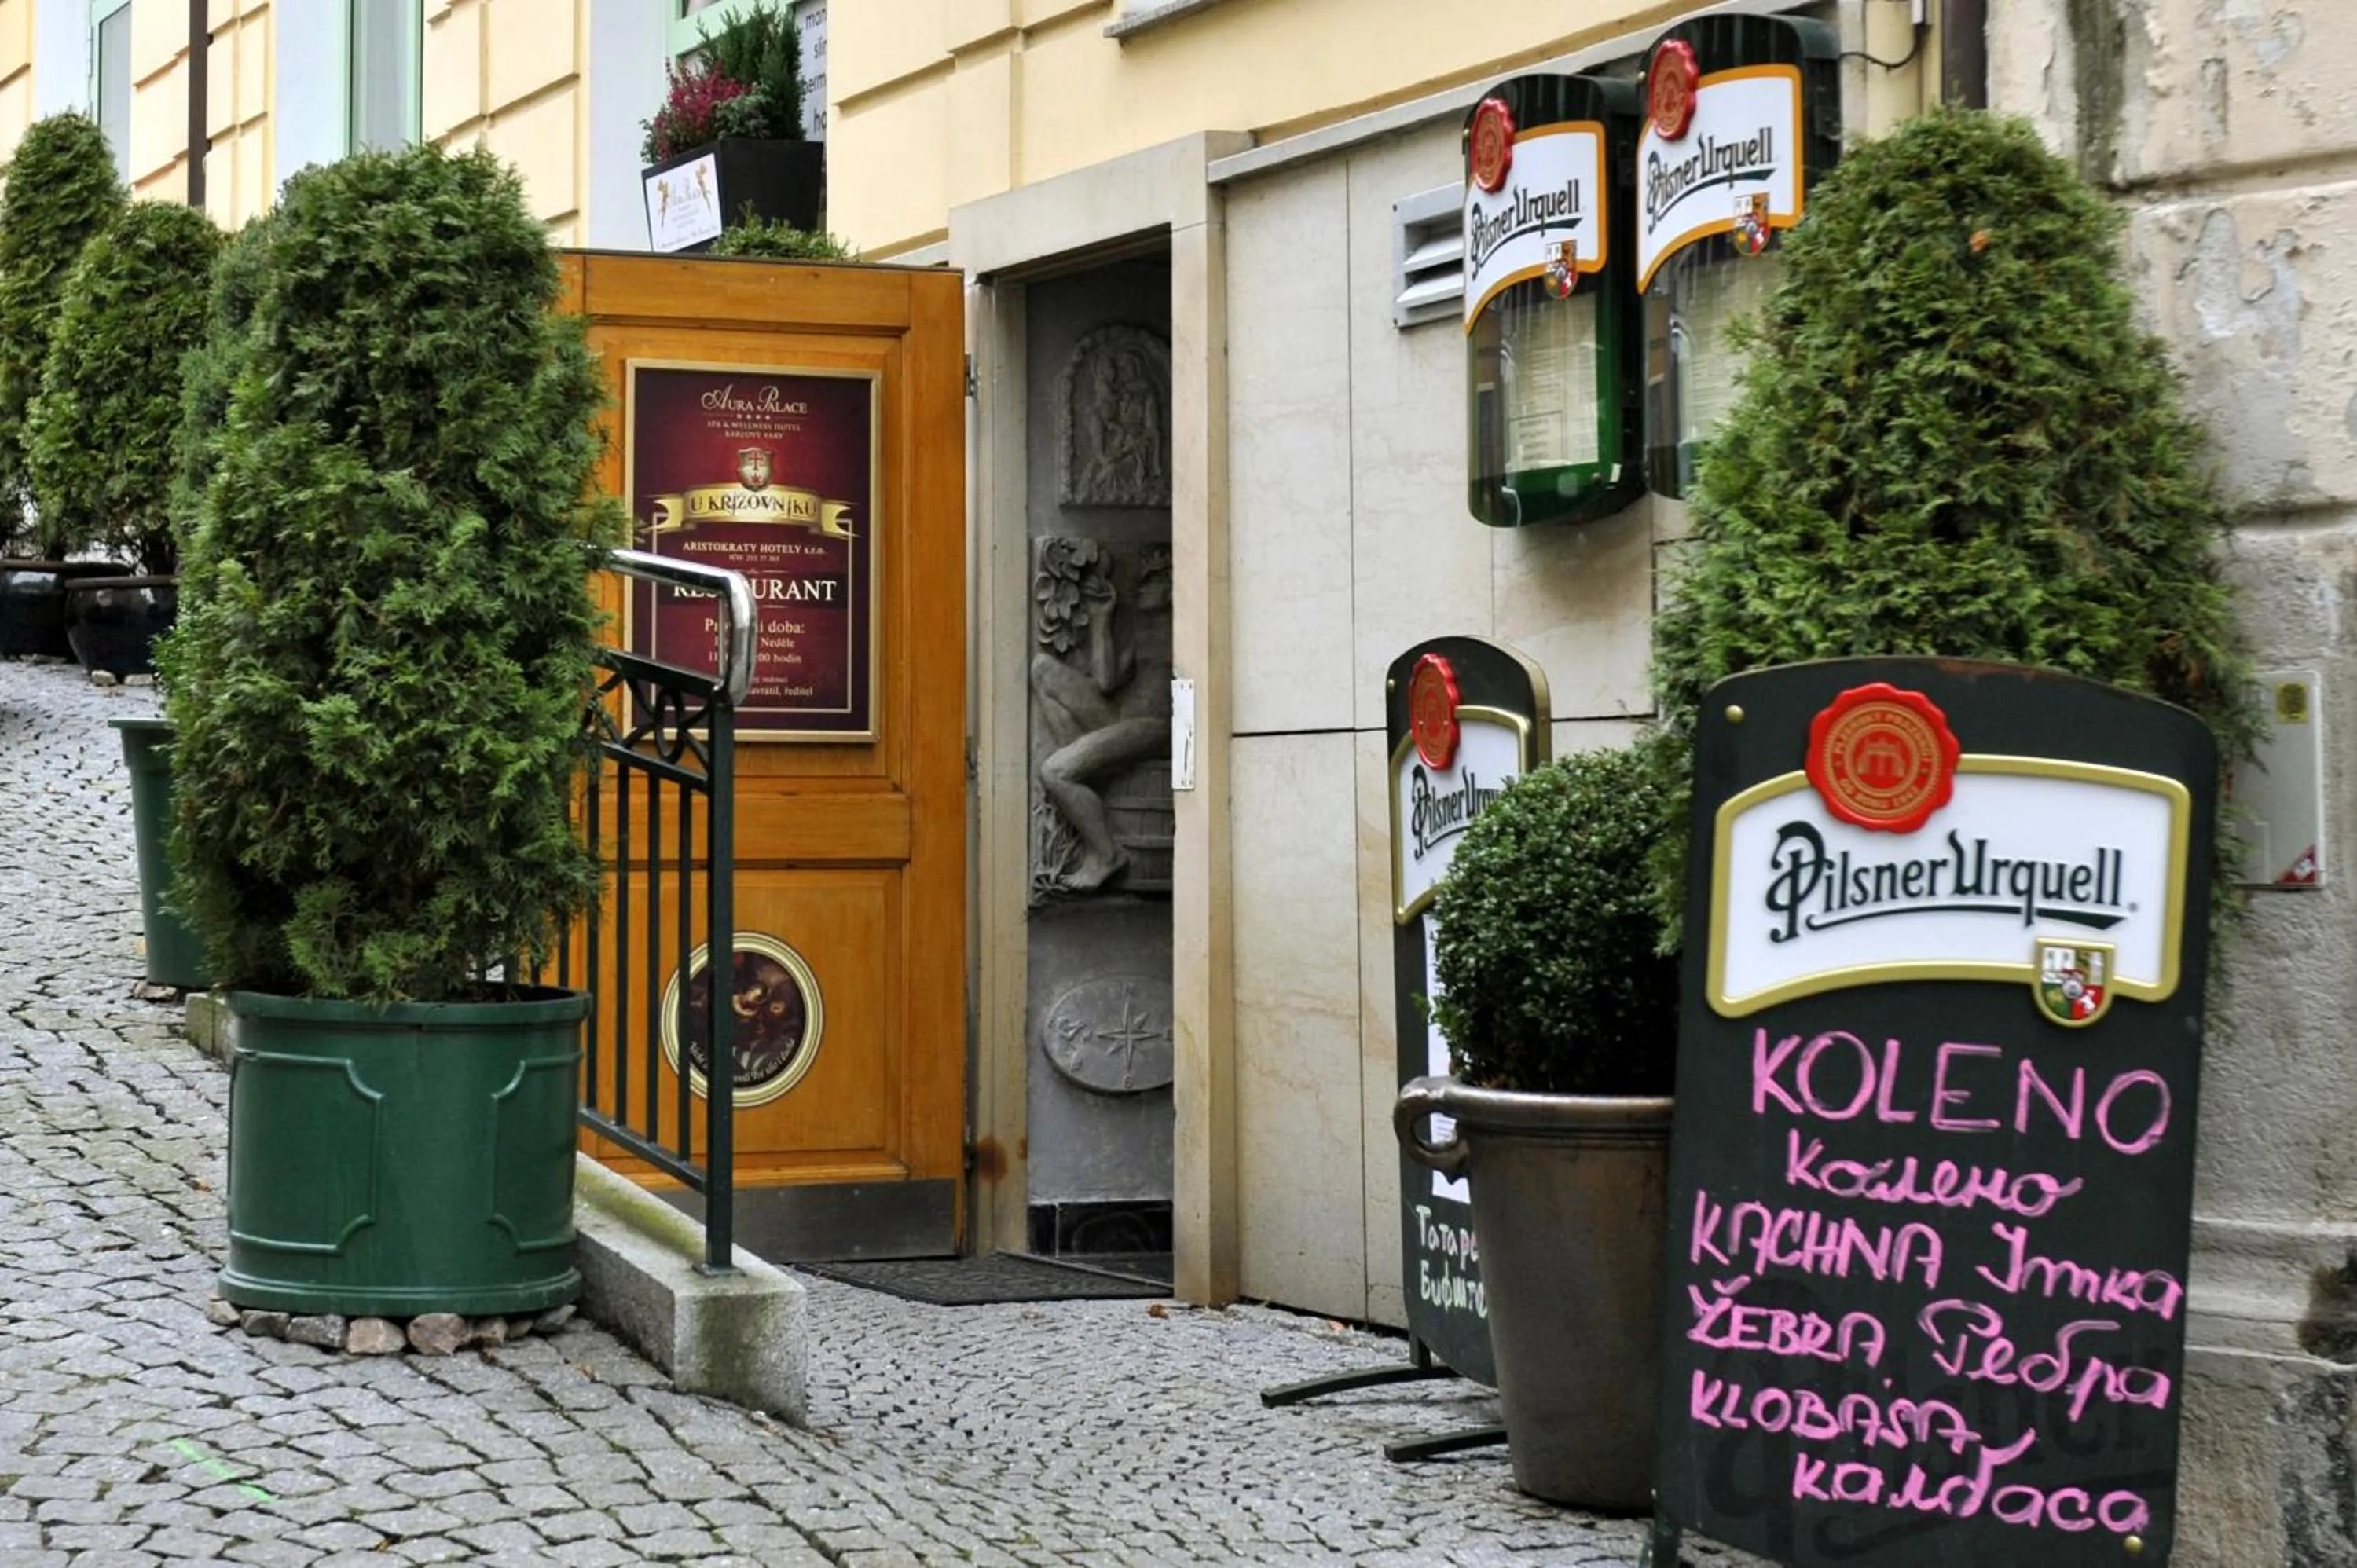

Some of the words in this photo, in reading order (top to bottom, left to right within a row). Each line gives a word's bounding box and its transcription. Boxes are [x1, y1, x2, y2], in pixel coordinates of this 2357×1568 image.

[1471, 202, 1515, 280] Pilsner
[1513, 178, 1579, 237] Urquell
[1647, 151, 1699, 234] Pilsner
[1698, 126, 1772, 189] Urquell
[683, 541, 757, 553] ARISTOKRATY
[760, 544, 801, 555] HOTELY
[691, 496, 703, 511] U
[1412, 764, 1464, 860] Pilsner
[1765, 820, 1949, 943] Pilsner
[1948, 829, 2122, 929] Urquell
[1751, 1028, 2172, 1156] KOLENO
[1690, 1189, 1943, 1290] KACHNA
